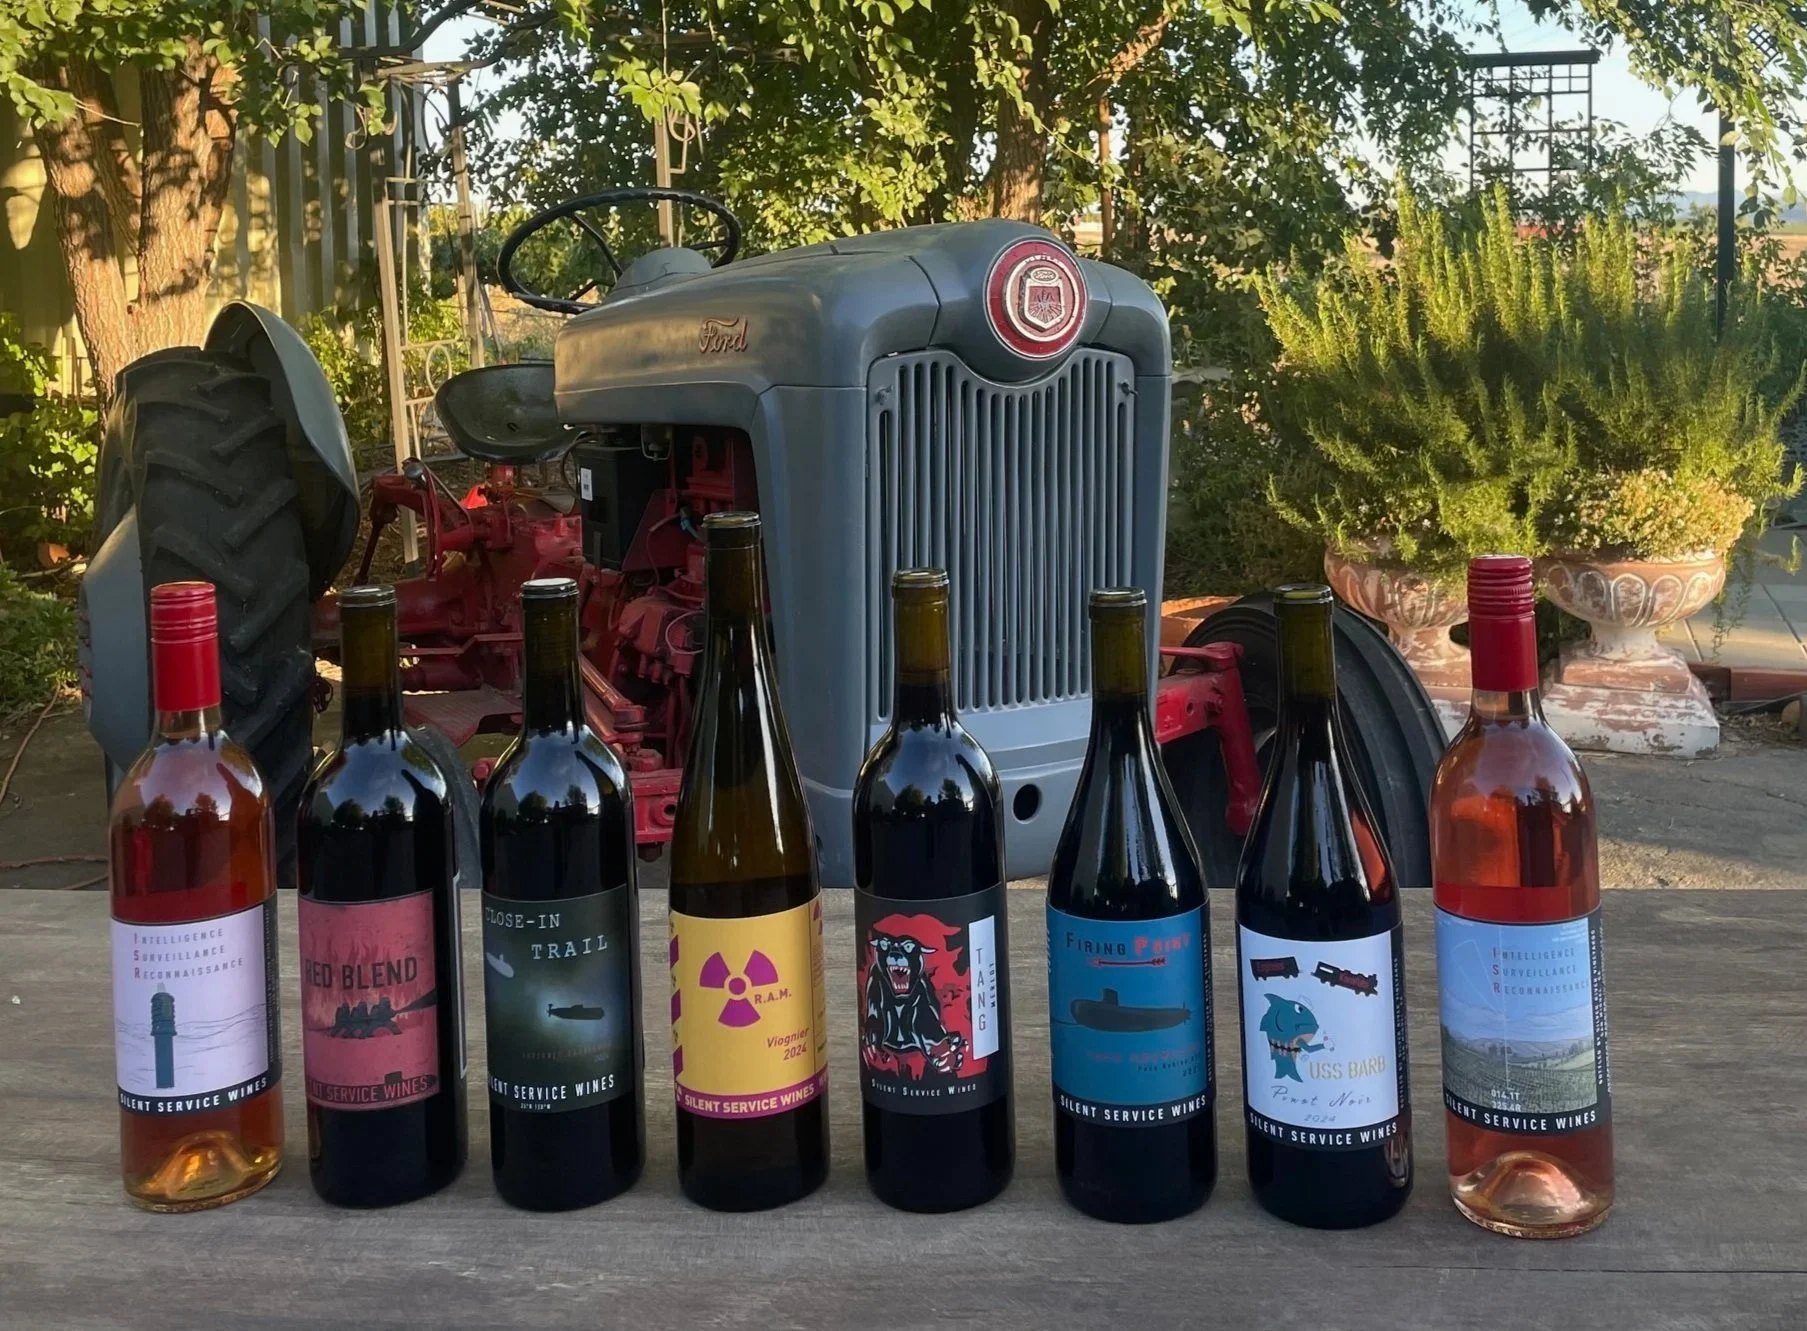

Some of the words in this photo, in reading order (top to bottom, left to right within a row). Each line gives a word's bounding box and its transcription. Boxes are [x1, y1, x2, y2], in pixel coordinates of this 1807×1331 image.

[699, 317, 748, 353] Ford
[486, 907, 561, 929] CLOSE-IN
[134, 928, 224, 945] INTELLIGENCE
[531, 935, 608, 960] TRAIL
[1066, 932, 1126, 955] FIRING
[134, 945, 225, 962] SURVEILLANCE
[1492, 947, 1575, 961] INTELLIGENCE
[134, 958, 243, 980] RECONNAISSANCE
[342, 956, 418, 990] BLEND
[1493, 964, 1577, 978] SURVEILLANCE
[754, 988, 792, 1005] R.A.M.
[975, 948, 986, 1031] TANG
[767, 1027, 810, 1048] Viognier
[783, 1043, 807, 1061] 2024
[1309, 1061, 1343, 1080] USS
[1348, 1055, 1387, 1078] BARB
[120, 1093, 151, 1112] SILENT
[157, 1094, 220, 1113] SERVICE
[228, 1077, 267, 1102] WINES
[326, 1084, 377, 1102] SERVICE
[383, 1077, 428, 1099] WINES
[514, 1084, 567, 1101] SERVICE
[575, 1073, 615, 1097] WINES
[902, 1087, 940, 1097] SERVICE
[948, 1084, 977, 1095] WINES
[685, 1094, 719, 1113] SILENT
[723, 1097, 777, 1114] SERVICE
[780, 1084, 815, 1106] WINES
[1060, 1094, 1097, 1118] SILENT
[1104, 1108, 1164, 1122] SERVICE
[1171, 1095, 1206, 1117] WINES
[1328, 1092, 1372, 1107] Noir
[1250, 1112, 1284, 1138] SILENT
[1291, 1129, 1352, 1145] SERVICE
[1360, 1121, 1397, 1144] WINES
[1484, 1113, 1548, 1131] SERVICE
[1555, 1110, 1596, 1129] WINES
